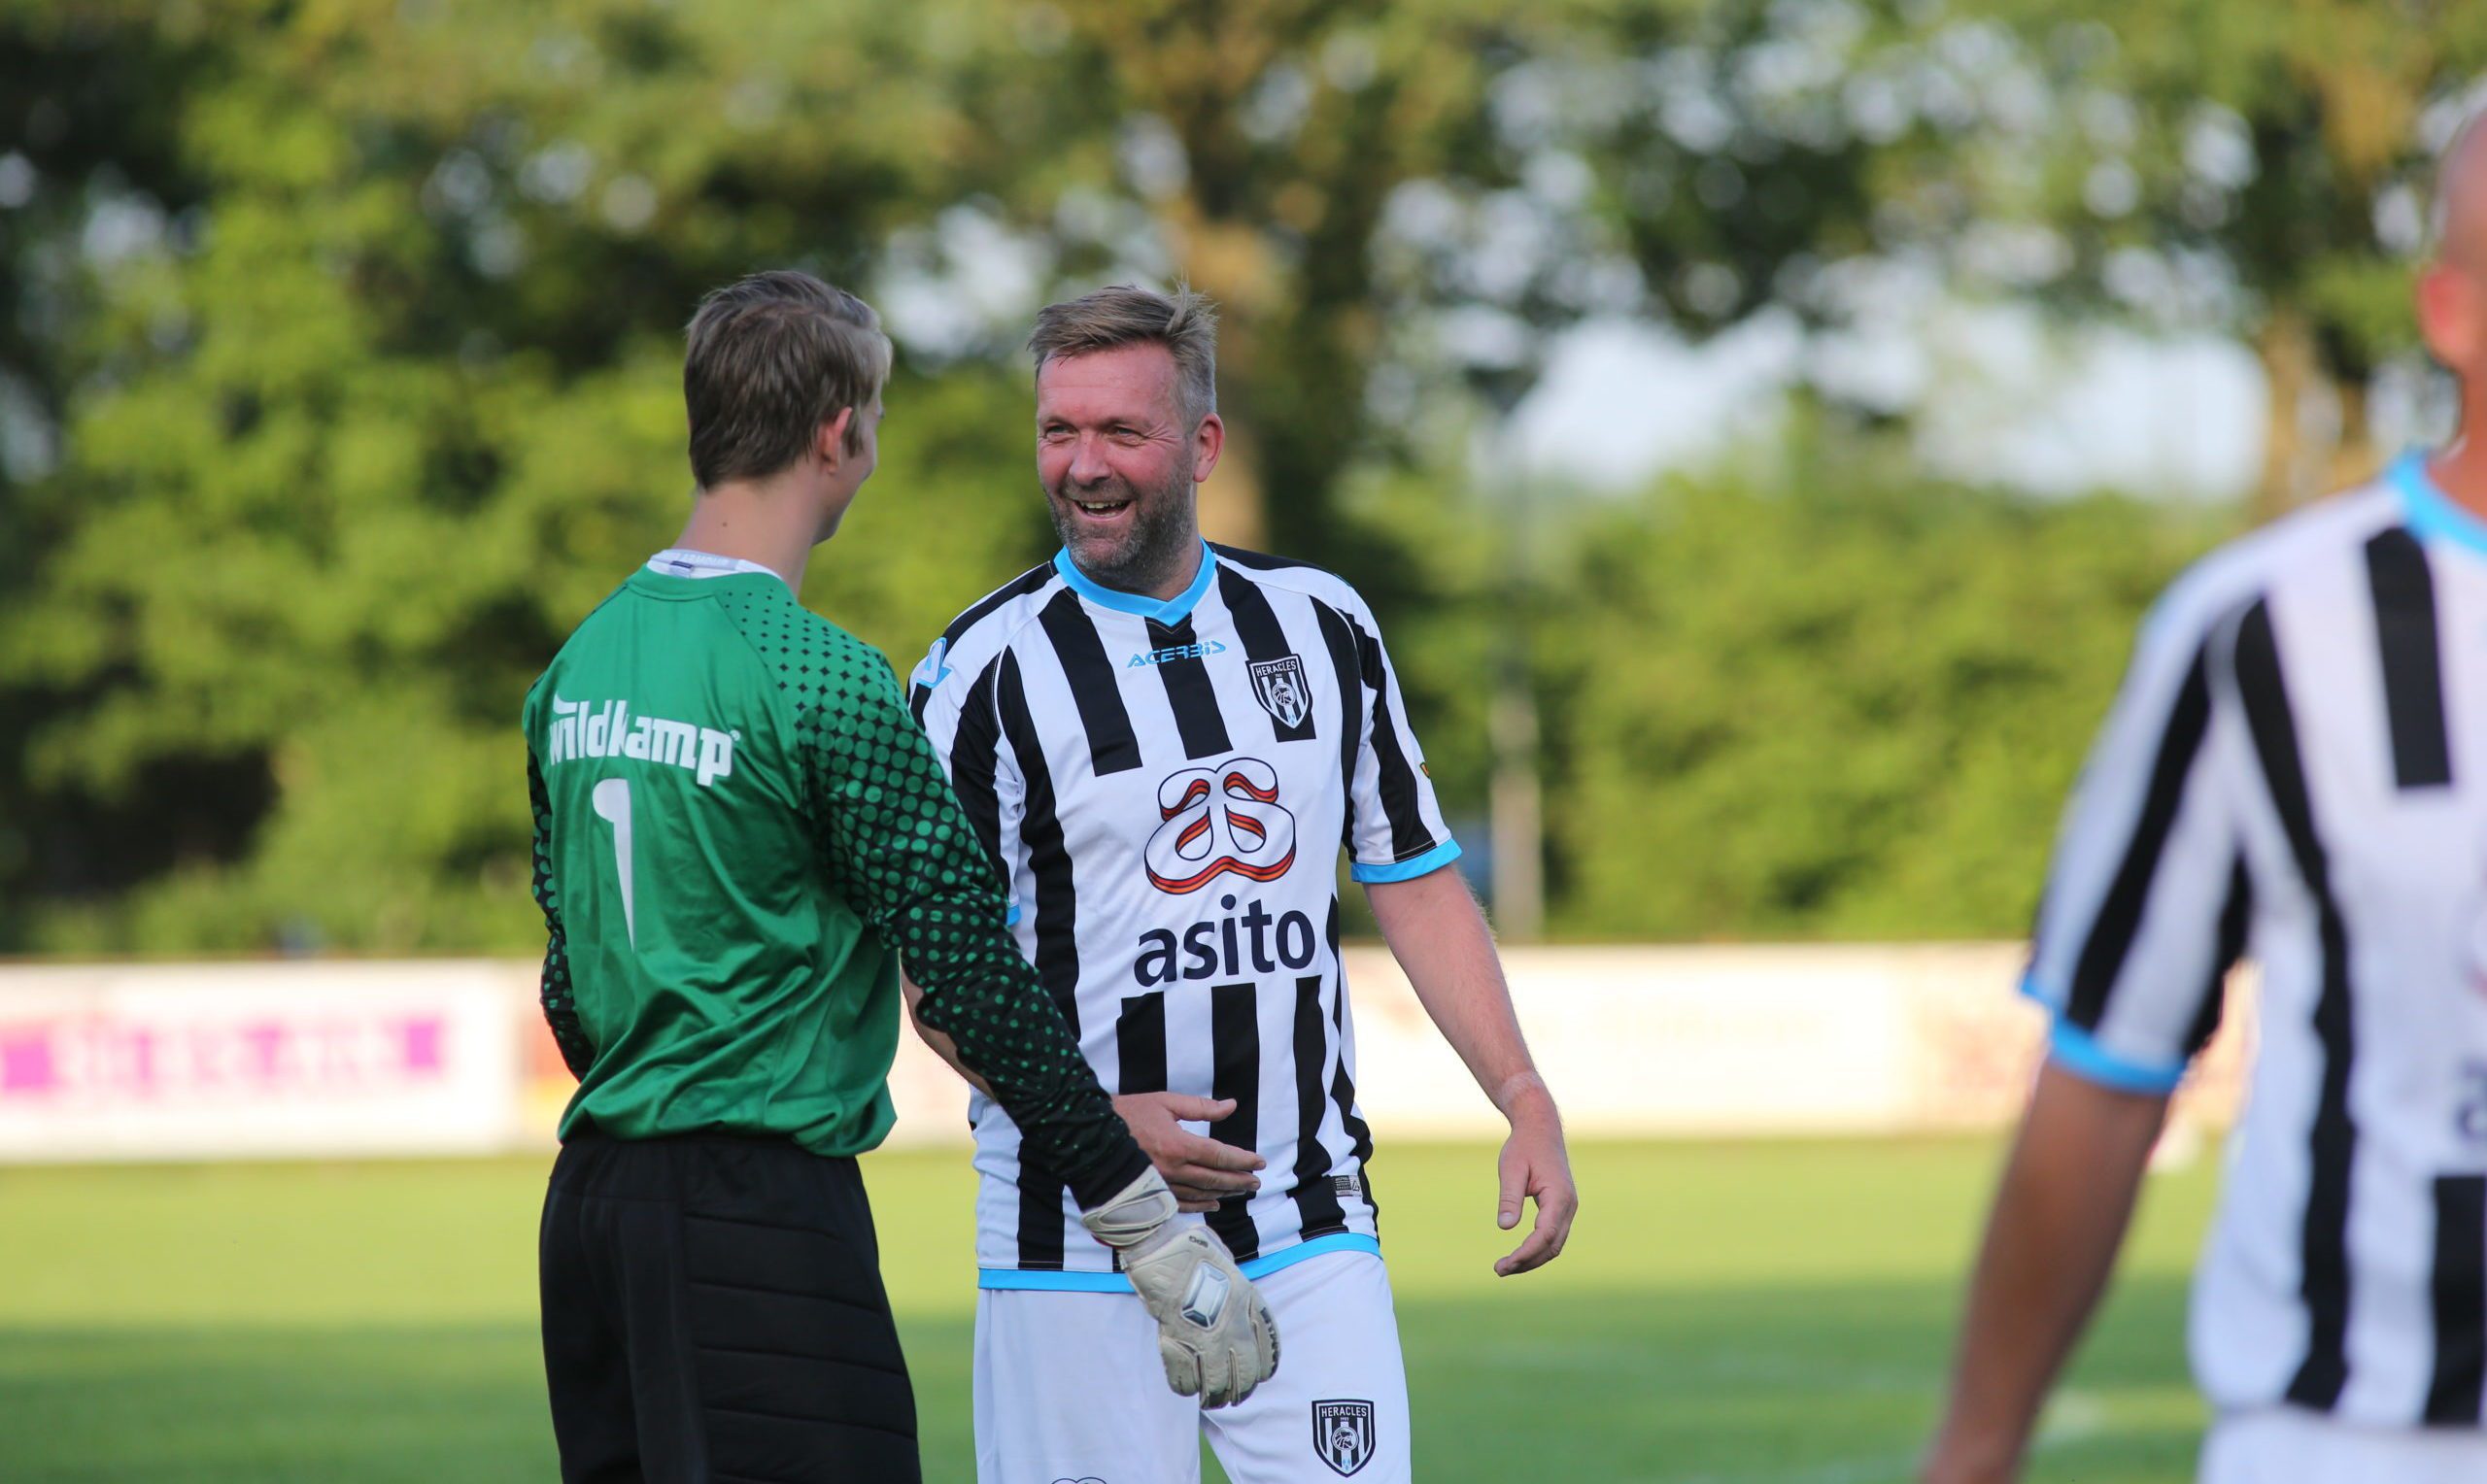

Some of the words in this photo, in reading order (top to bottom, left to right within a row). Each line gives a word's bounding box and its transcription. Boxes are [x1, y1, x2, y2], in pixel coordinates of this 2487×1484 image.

[1255, 660, 1297, 677] HERACLES
[592, 778, 634, 952] 1
[1134, 894, 1316, 987] asito
[1321, 1406, 1367, 1417] HERACLES
